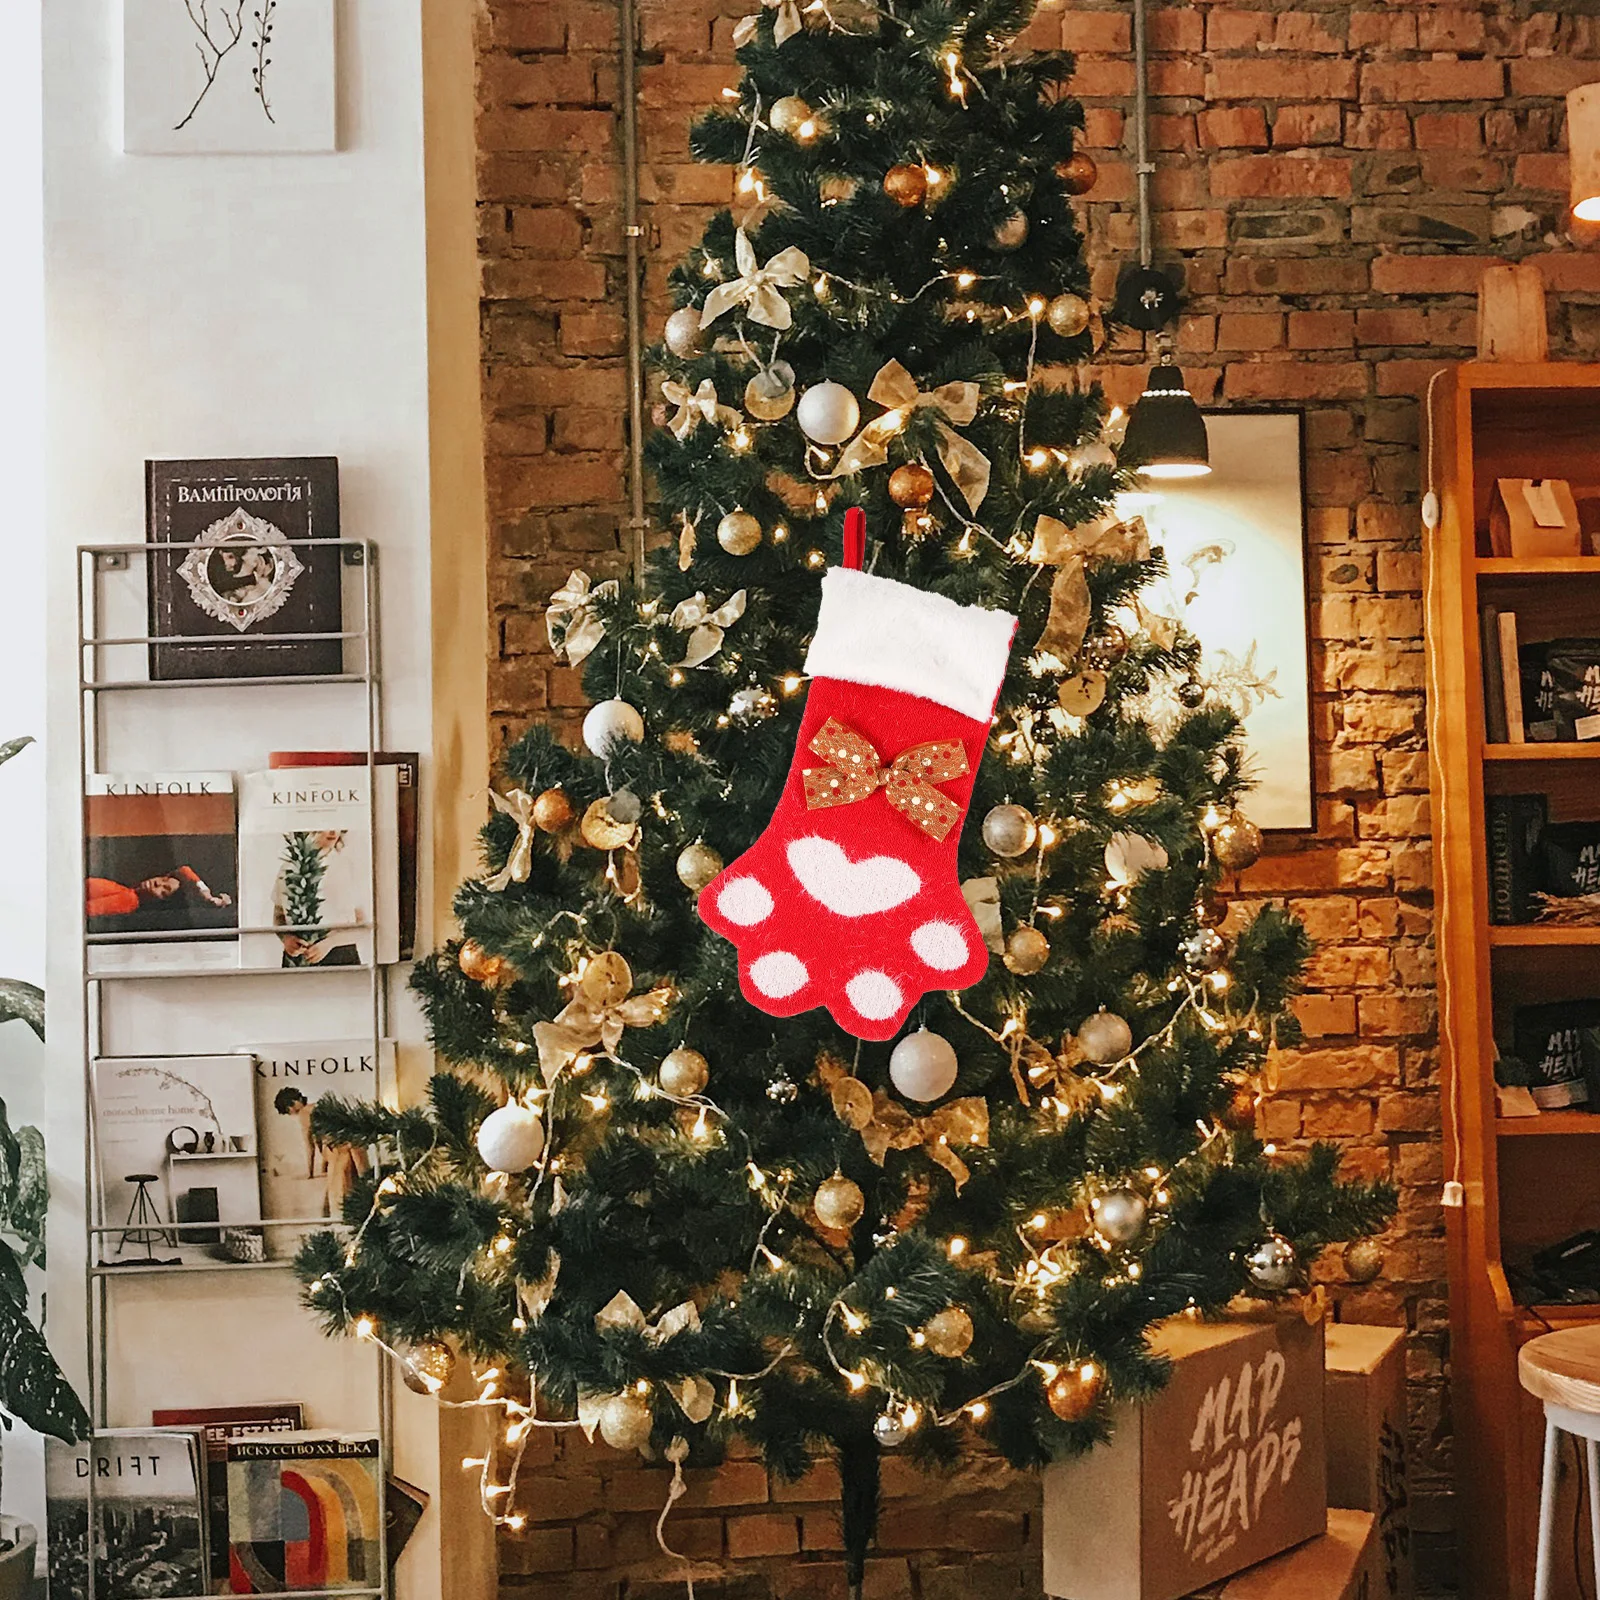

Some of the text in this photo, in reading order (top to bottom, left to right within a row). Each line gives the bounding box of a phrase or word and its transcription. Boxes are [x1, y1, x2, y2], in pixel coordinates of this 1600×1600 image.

[106, 781, 213, 798] KINFOLK
[272, 789, 360, 804] KINFOLK
[255, 1056, 373, 1078] KINFOLK
[103, 1105, 195, 1117] monochrome home
[237, 1445, 314, 1456] ИСКУССТВО
[338, 1443, 371, 1454] ВЕКА
